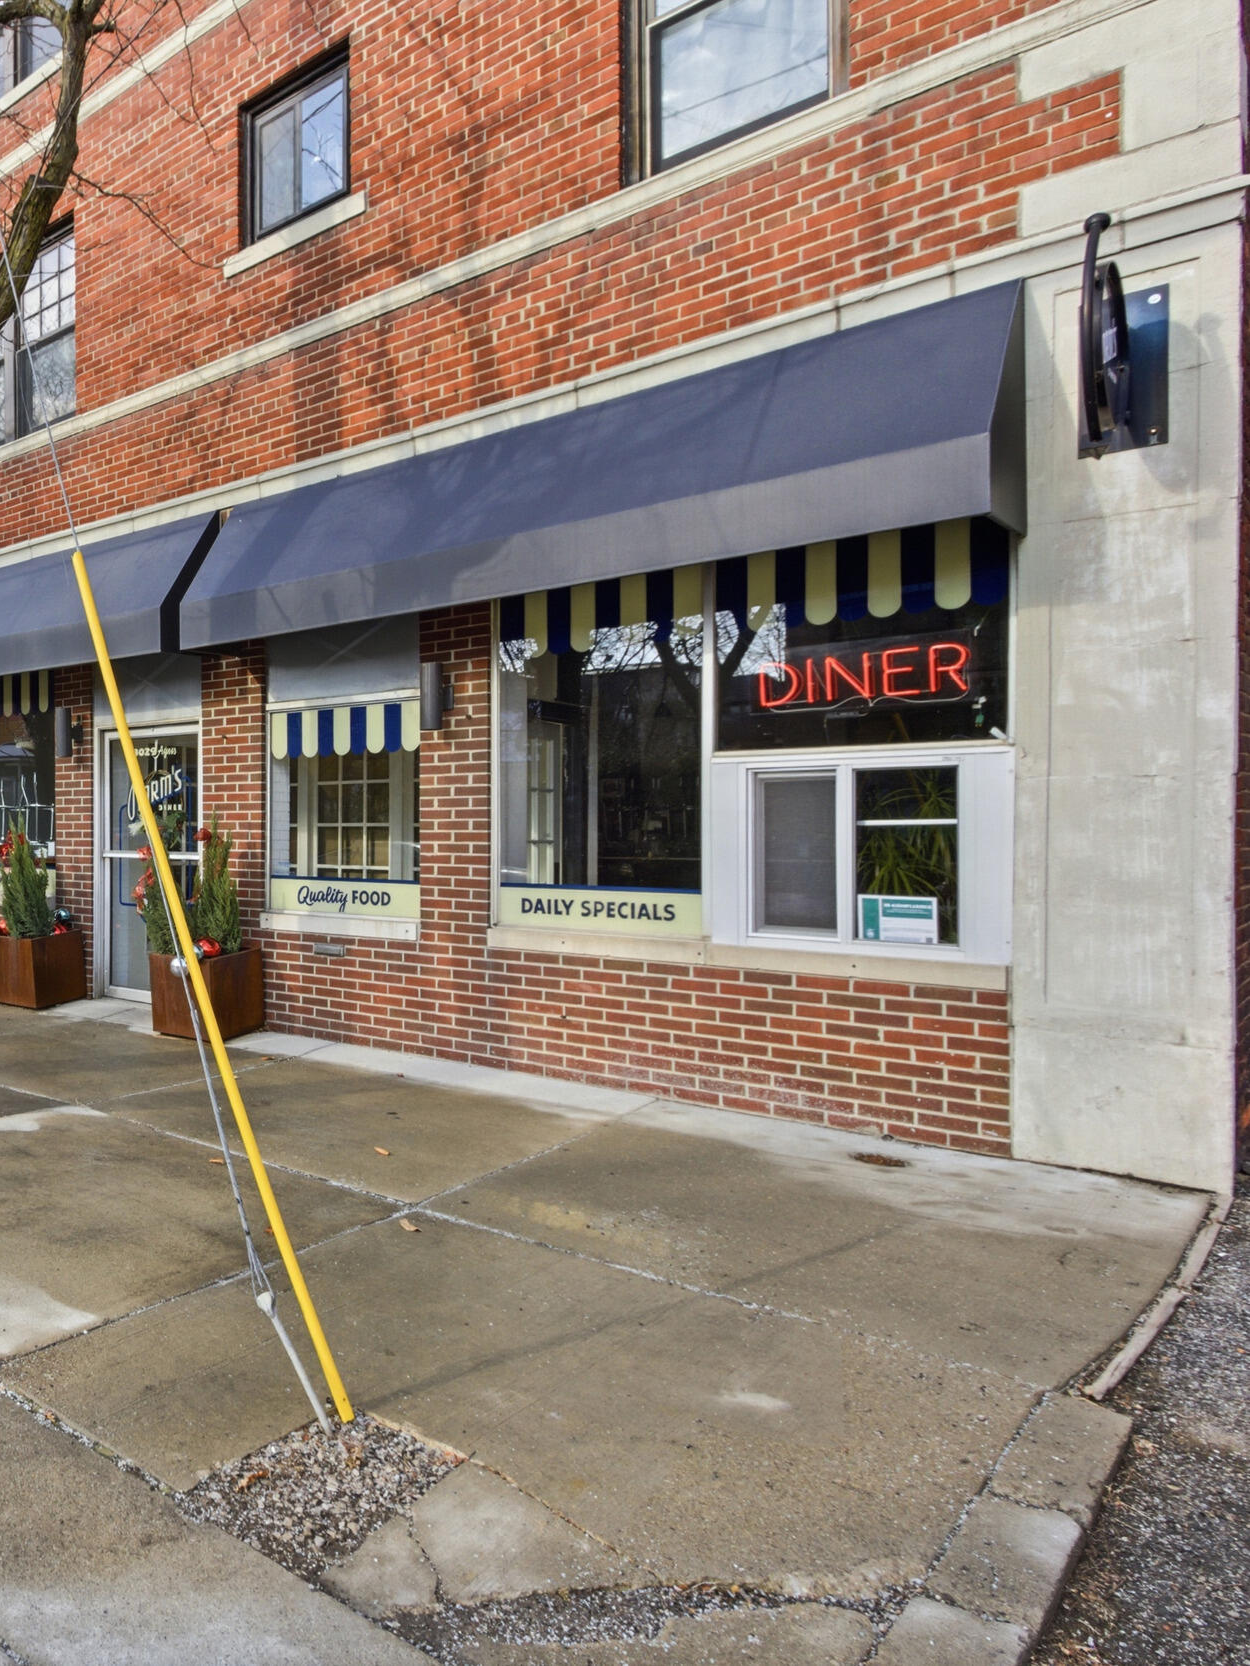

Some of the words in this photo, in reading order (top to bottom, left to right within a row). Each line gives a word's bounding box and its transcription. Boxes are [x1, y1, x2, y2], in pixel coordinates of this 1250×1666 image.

[759, 643, 970, 707] DINER
[158, 803, 182, 812] DINER
[297, 885, 348, 913] Quality
[352, 890, 391, 907] FOOD
[521, 897, 575, 916] DAILY
[581, 900, 676, 922] SPECIALS
